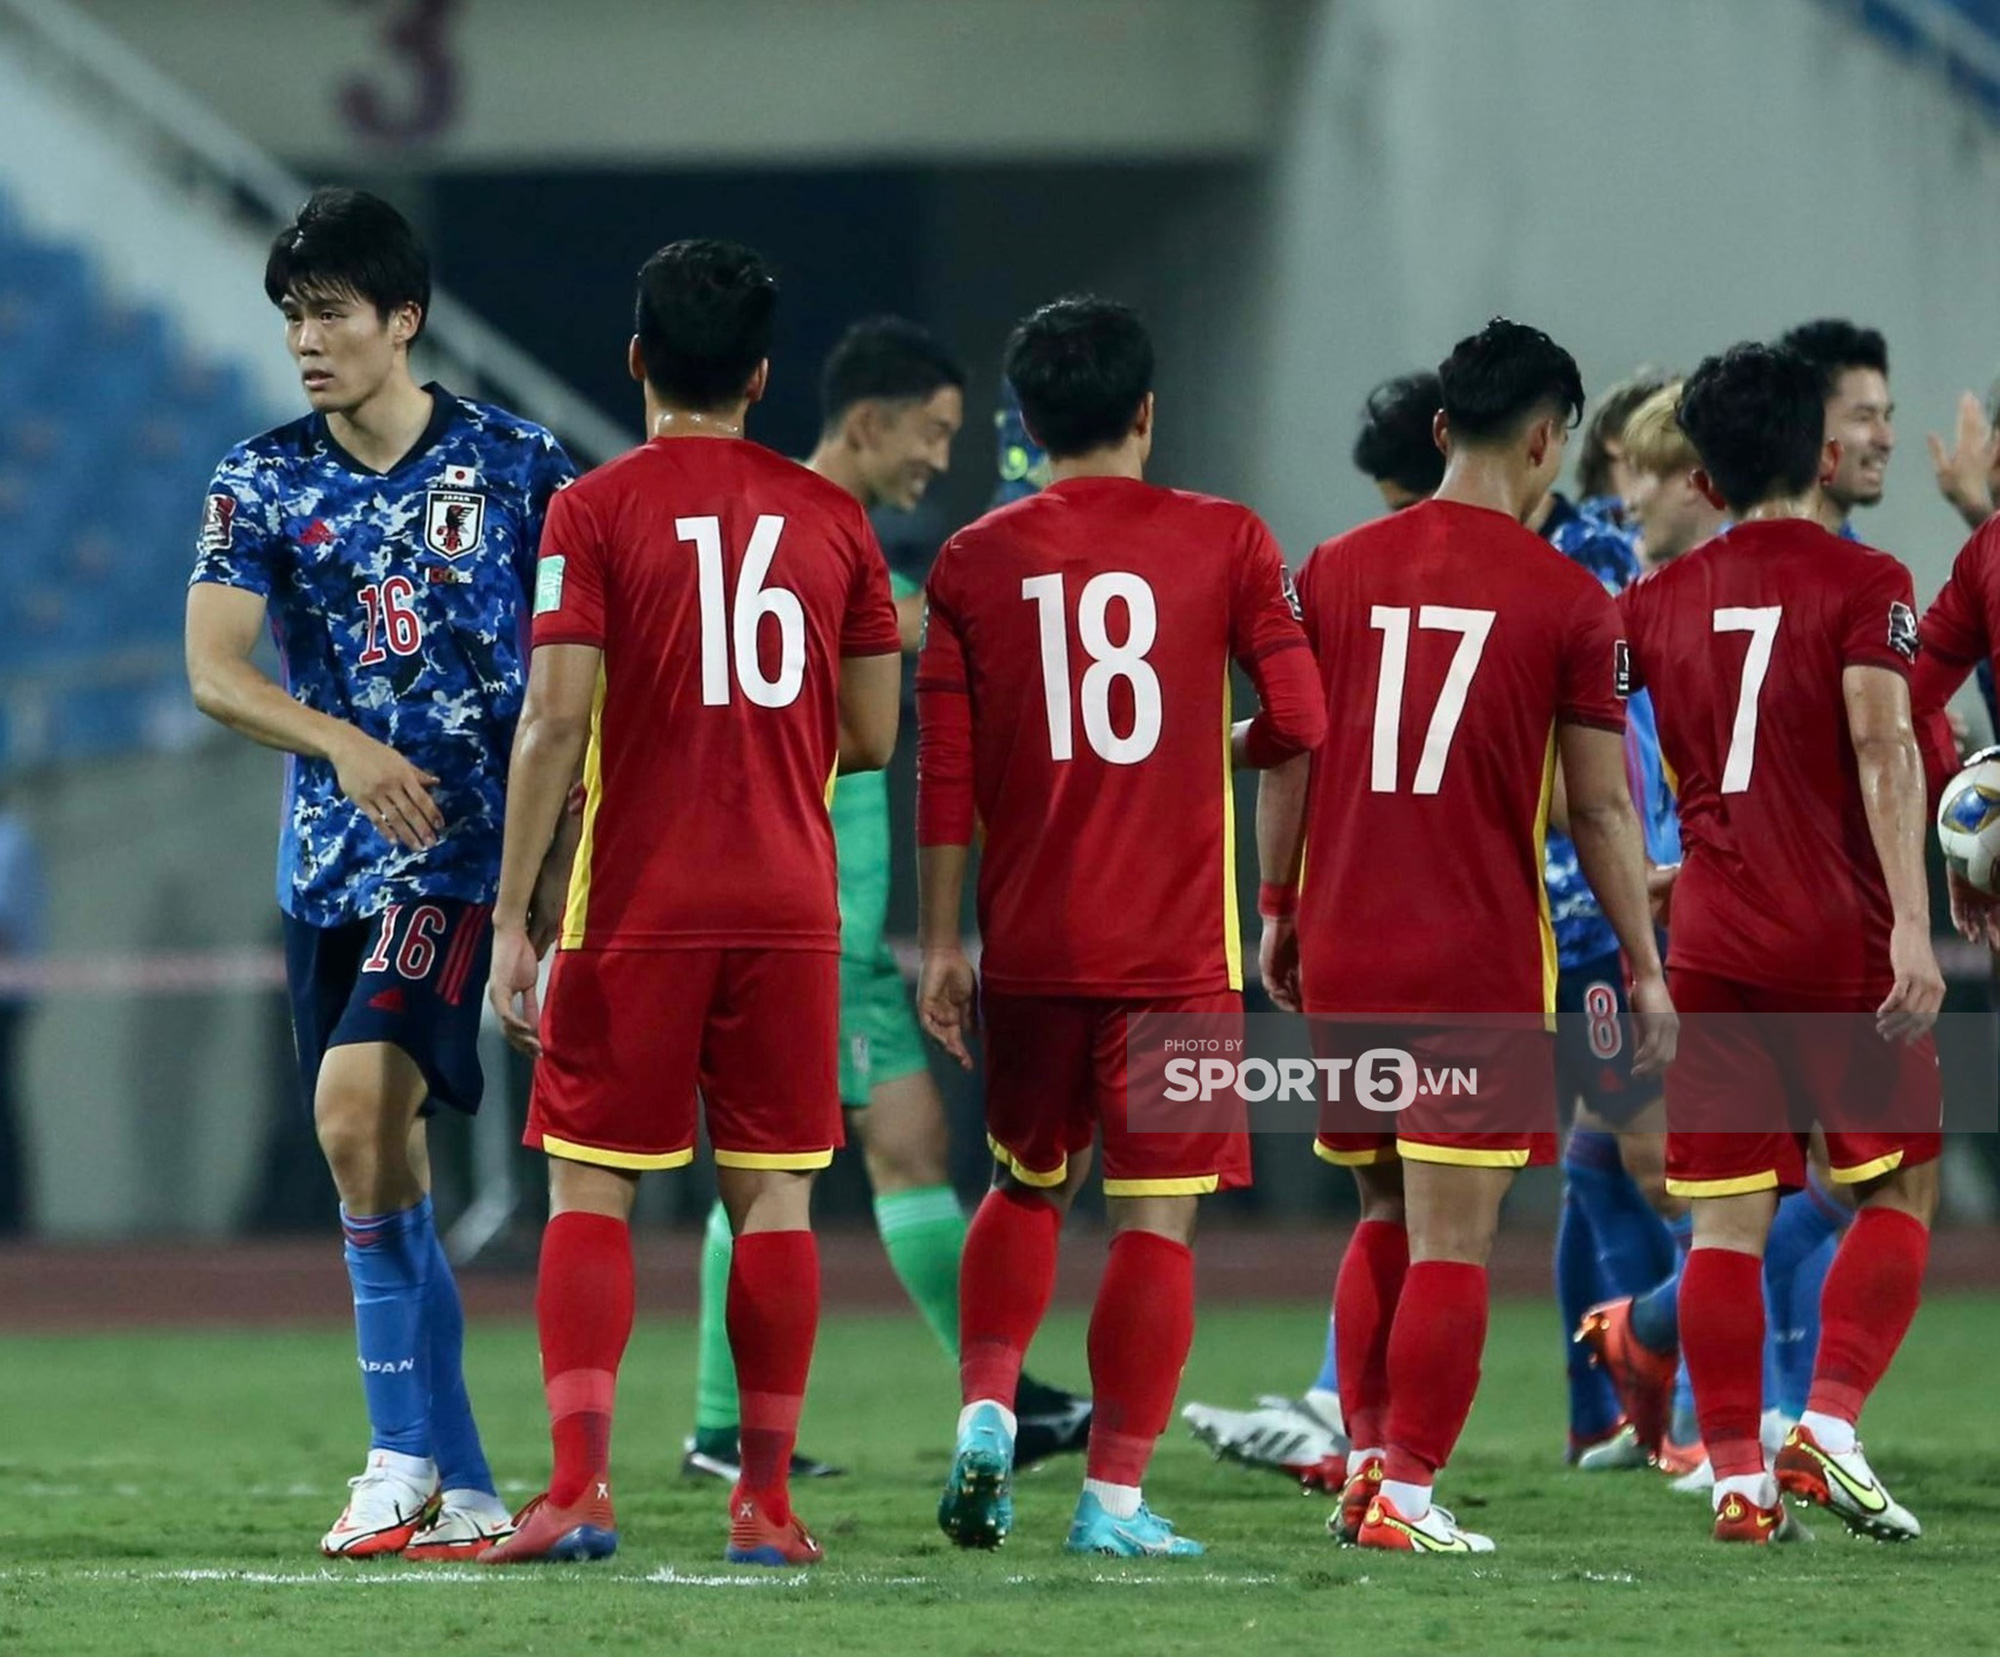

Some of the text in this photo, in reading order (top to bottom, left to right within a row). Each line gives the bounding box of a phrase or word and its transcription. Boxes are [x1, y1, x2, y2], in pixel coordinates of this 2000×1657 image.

[357, 575, 422, 666] 16
[674, 514, 807, 708] 16
[1021, 571, 1163, 765] 18
[1370, 604, 1496, 795] 17
[1713, 605, 1782, 794] 7
[362, 904, 446, 979] 16
[1584, 981, 1622, 1060] 8
[357, 1356, 415, 1374] APAN
